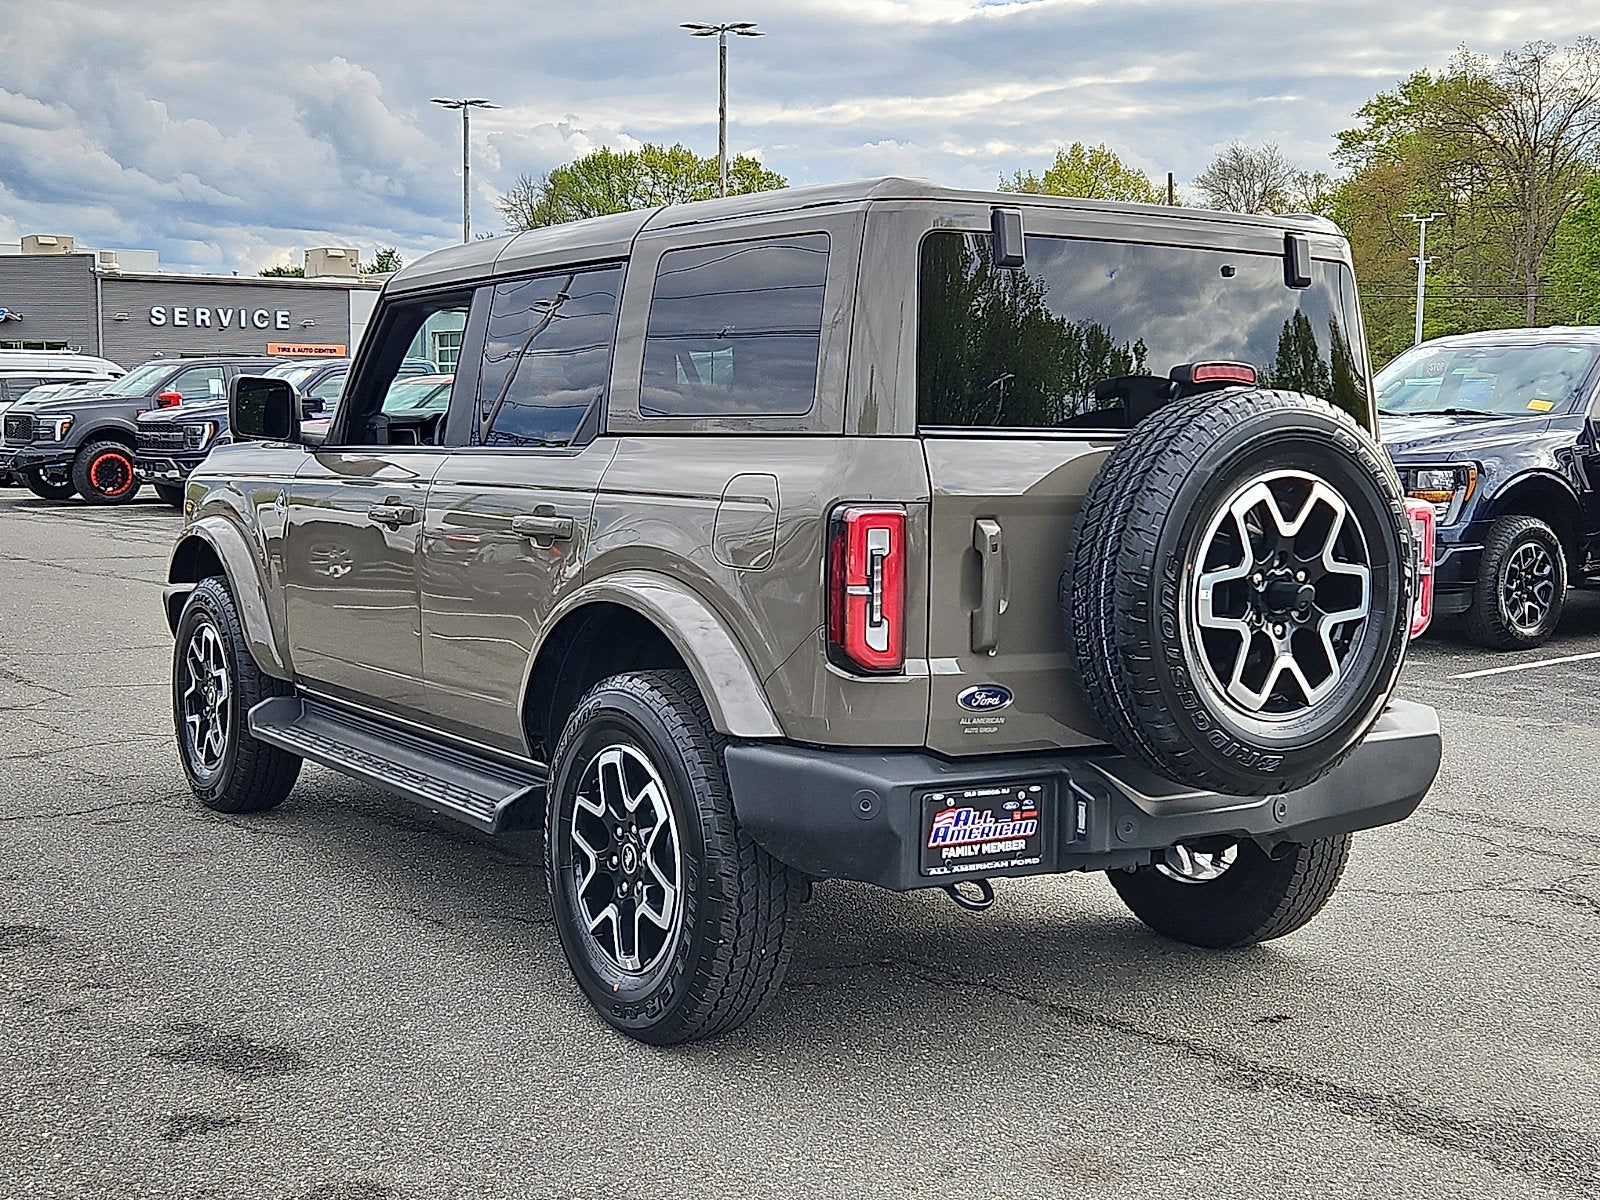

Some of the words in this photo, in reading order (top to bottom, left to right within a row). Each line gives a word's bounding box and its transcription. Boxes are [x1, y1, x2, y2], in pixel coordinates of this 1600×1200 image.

[149, 306, 291, 329] SERVICE
[1428, 362, 1445, 371] STOP
[1160, 551, 1284, 772] BRIDGESTONE
[971, 691, 1001, 706] Ford
[959, 717, 971, 725] ALL
[972, 716, 1005, 724] AMERICAN
[942, 845, 980, 859] FAMILY
[982, 839, 1026, 855] MEMBER
[929, 867, 951, 875] ALL
[952, 860, 1009, 873] AMERICAN
[1010, 857, 1040, 867] FORD
